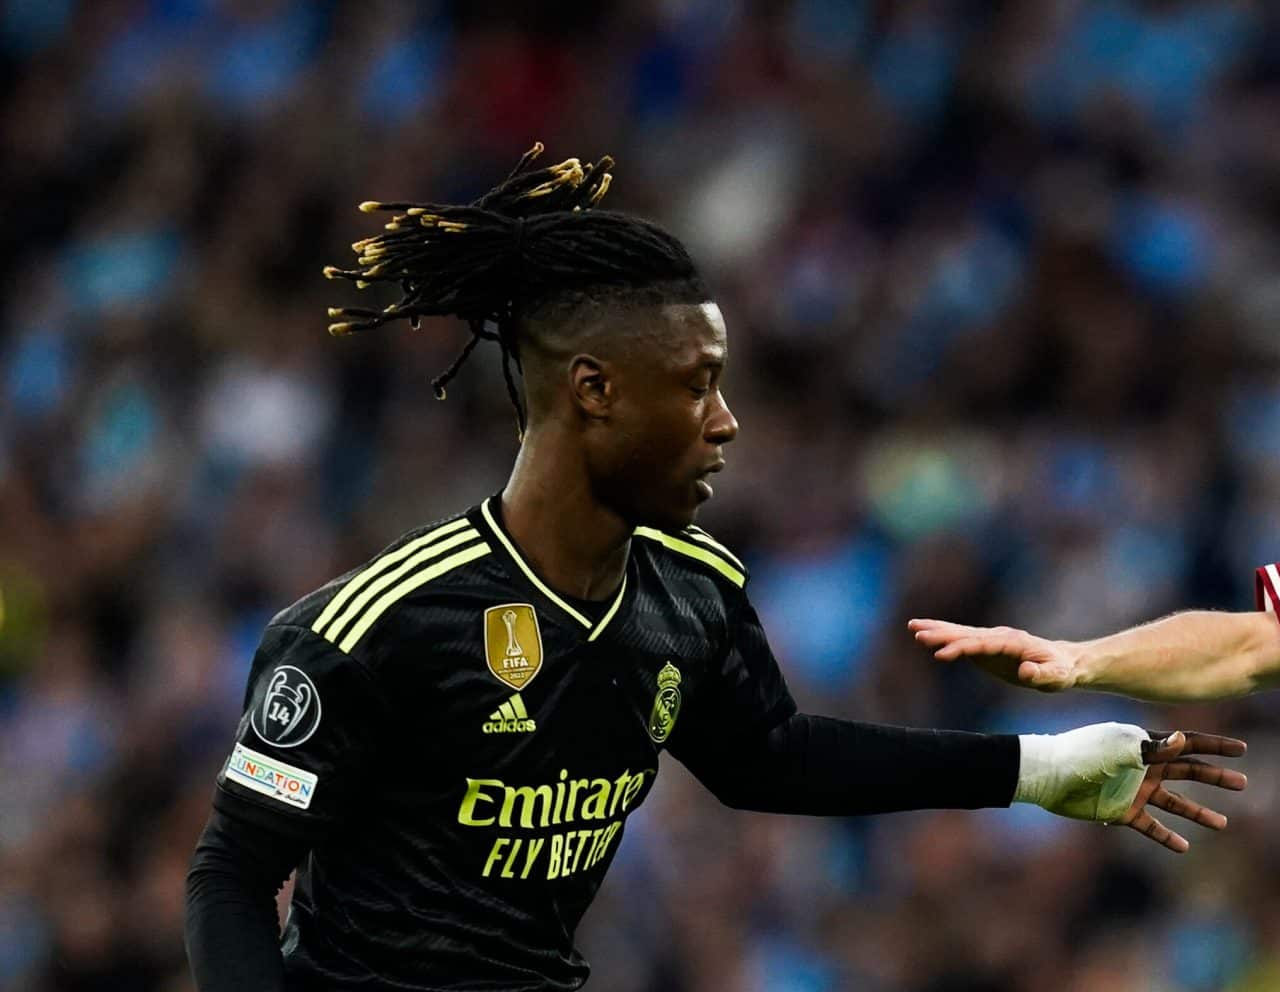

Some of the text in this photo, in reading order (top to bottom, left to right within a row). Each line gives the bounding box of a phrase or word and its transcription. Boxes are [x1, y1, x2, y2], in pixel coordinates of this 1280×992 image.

[503, 656, 529, 669] FIFA
[268, 701, 290, 726] 14
[482, 717, 537, 734] adidas
[482, 838, 545, 880] FLY
